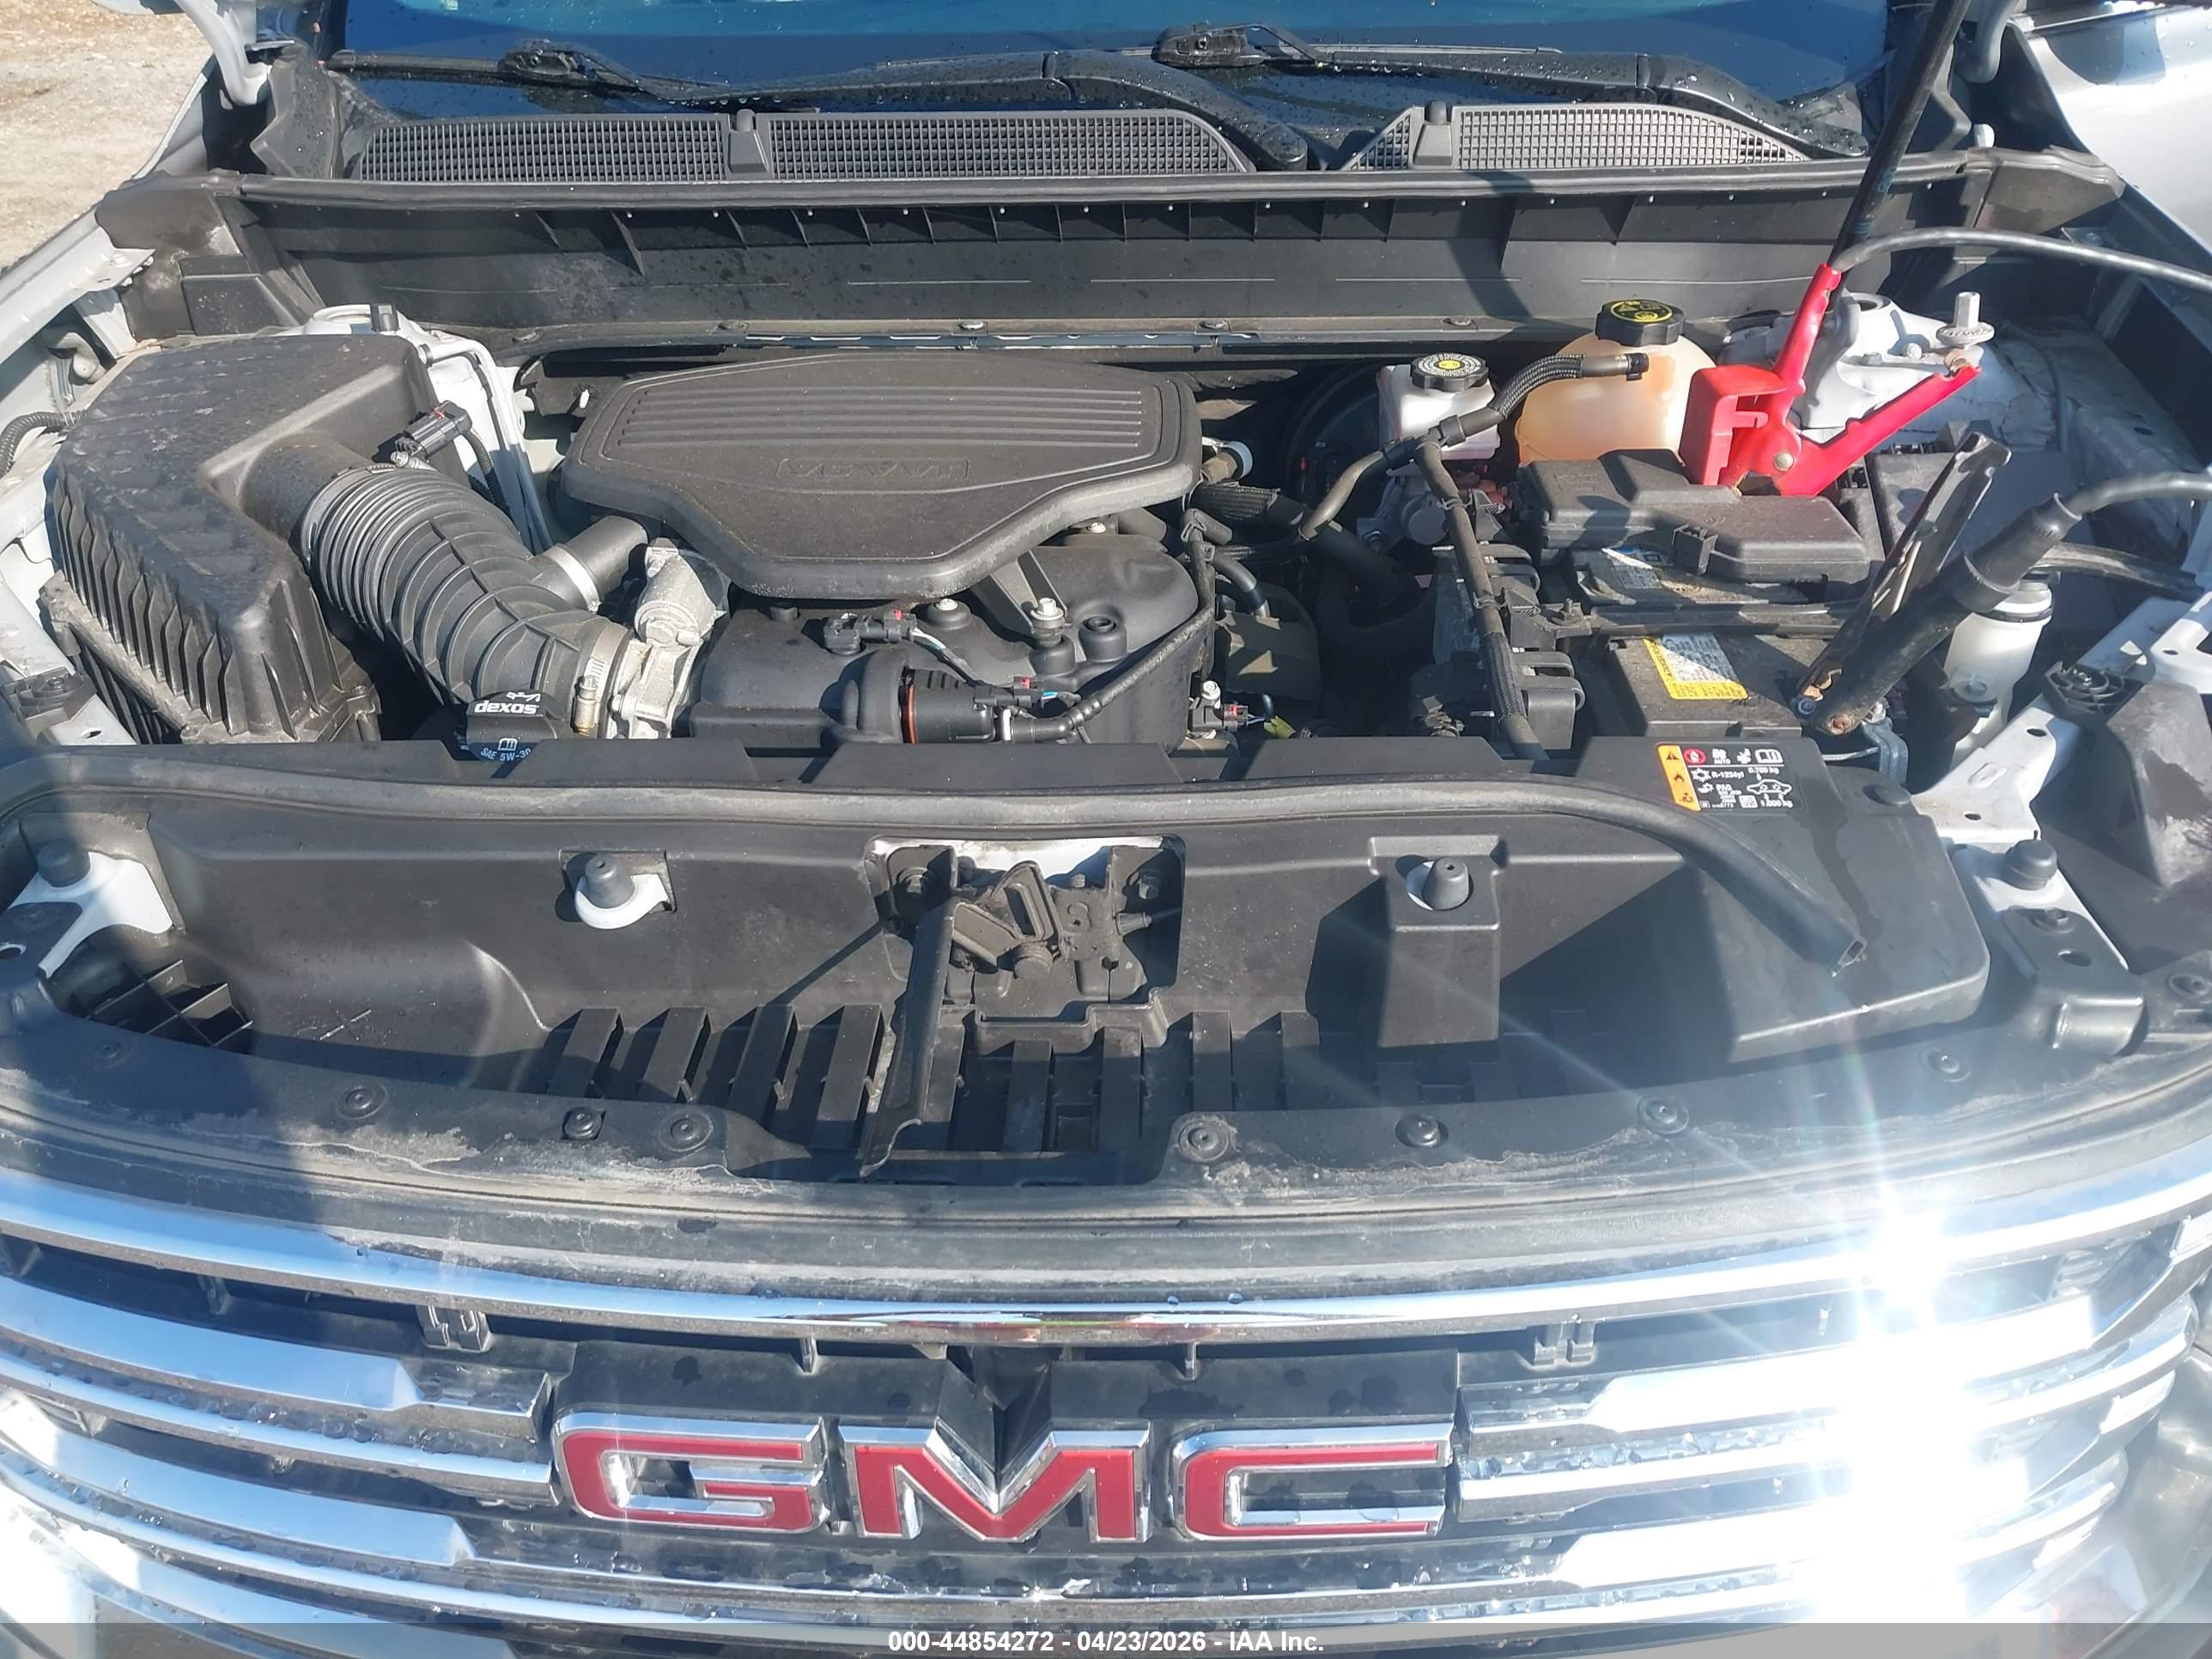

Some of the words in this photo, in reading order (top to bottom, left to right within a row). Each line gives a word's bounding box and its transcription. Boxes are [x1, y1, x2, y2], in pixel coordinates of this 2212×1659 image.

[474, 700, 538, 714] dexos
[481, 747, 497, 760] SAE
[554, 1407, 1455, 1543] GMC
